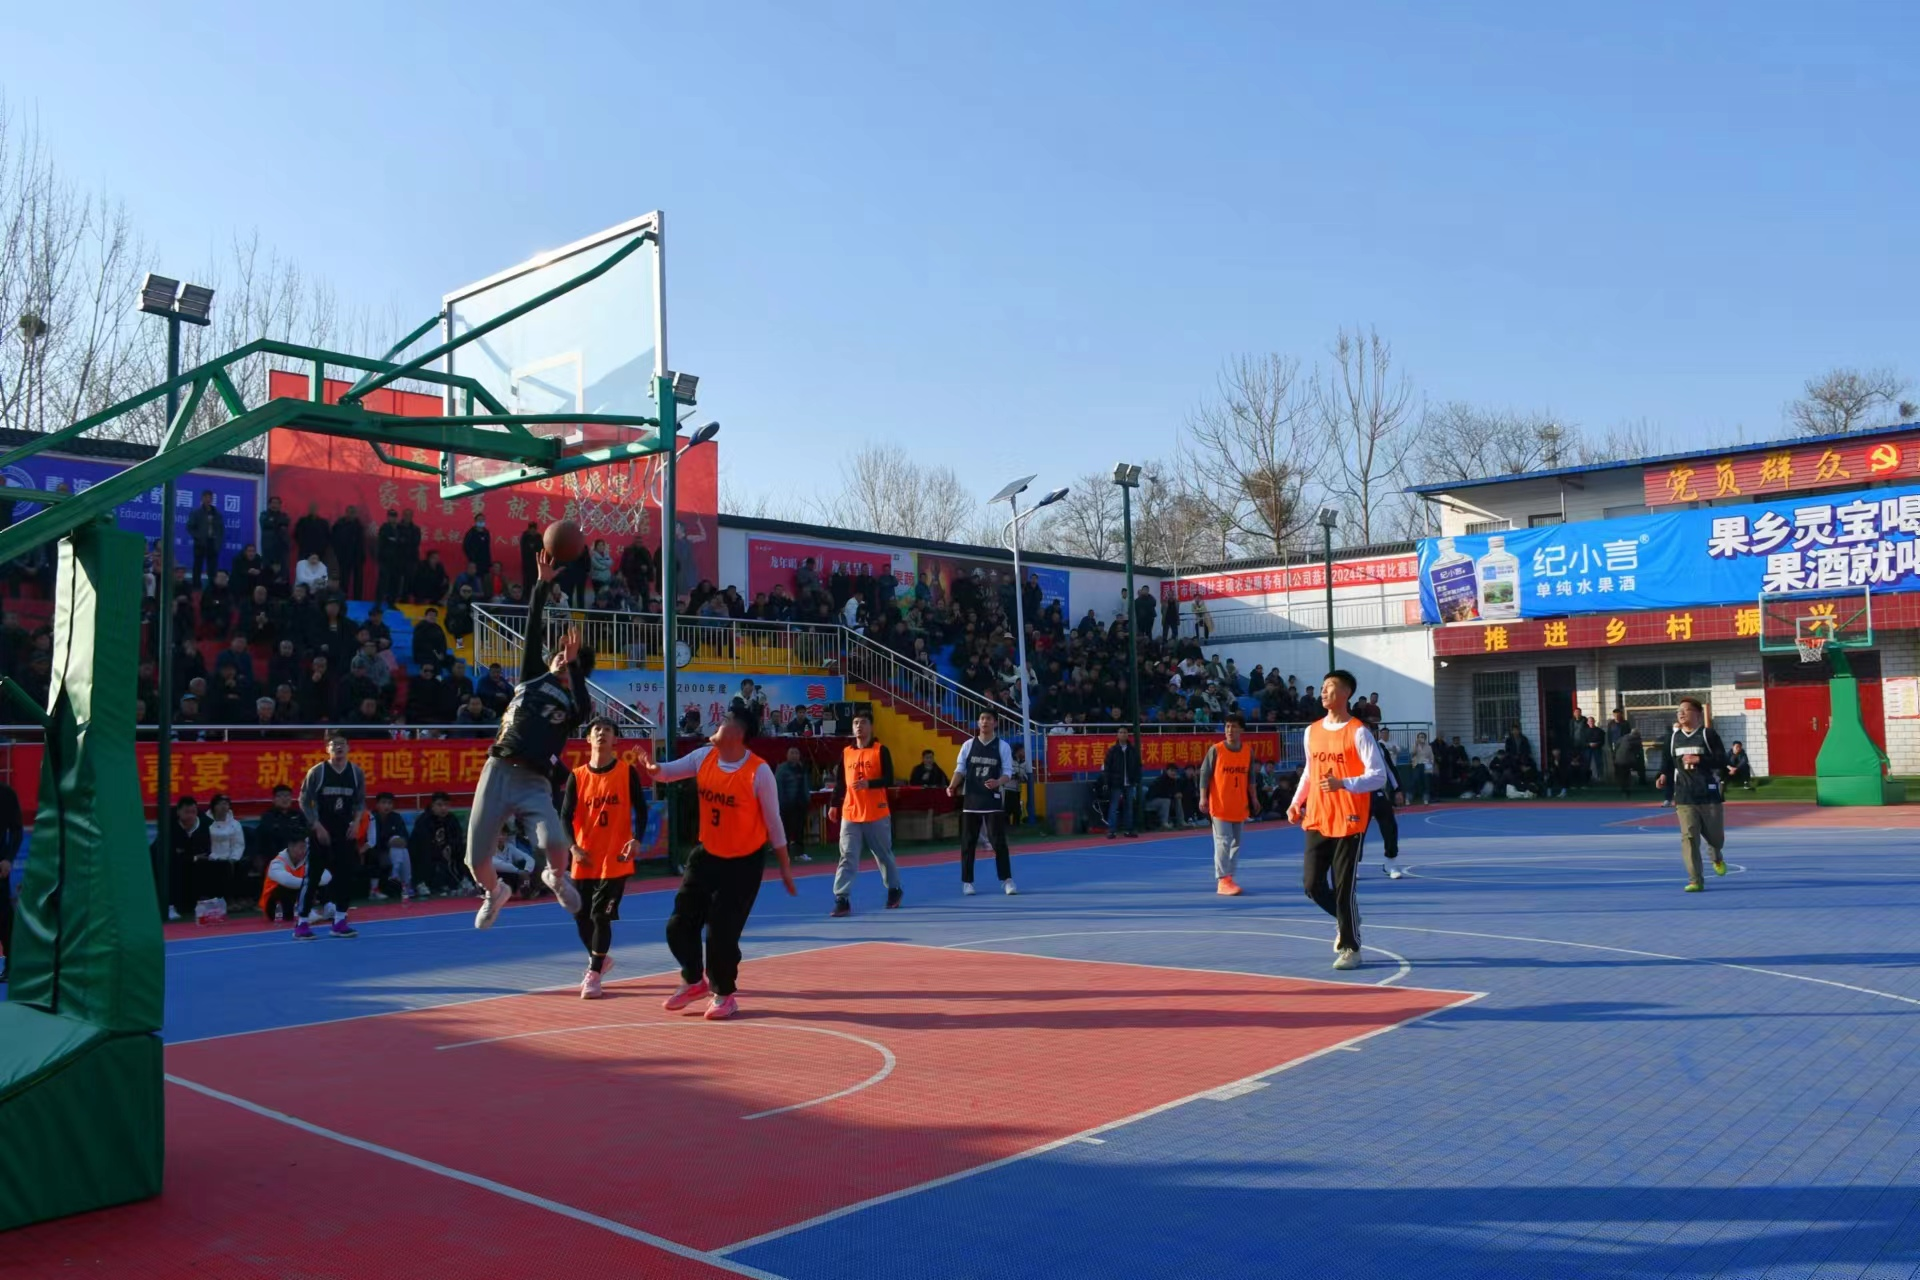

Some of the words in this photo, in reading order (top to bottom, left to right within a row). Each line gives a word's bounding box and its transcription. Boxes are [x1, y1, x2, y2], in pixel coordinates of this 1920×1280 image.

[1666, 447, 1850, 501] 党员群众
[1708, 495, 1920, 557] 果乡灵宝喝
[1533, 540, 1638, 577] 纪小言
[1536, 576, 1635, 597] 单纯水果酒
[1484, 604, 1837, 651] 推进乡村振兴
[698, 789, 735, 806] HOME
[711, 808, 720, 826] 3
